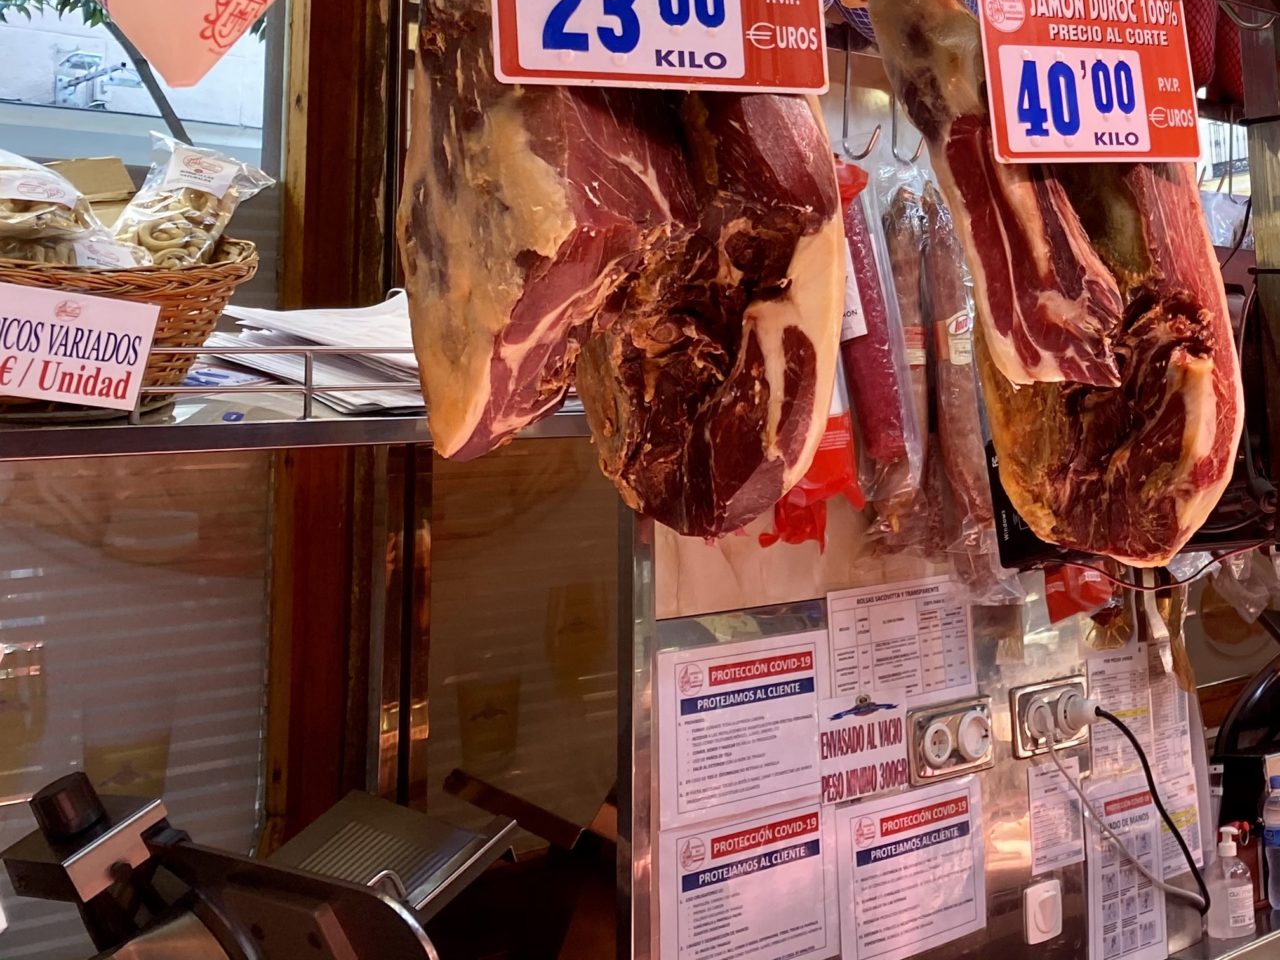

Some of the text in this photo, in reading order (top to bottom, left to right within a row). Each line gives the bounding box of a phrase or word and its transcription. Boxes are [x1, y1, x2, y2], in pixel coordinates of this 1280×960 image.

[1049, 24, 1169, 46] PRECIO AL CORTE
[655, 49, 727, 69] KILO
[1094, 132, 1139, 146] KILO
[0, 318, 143, 366] ICOS VARIADOS
[38, 360, 132, 401] Unidad
[711, 655, 811, 682] PROTECCIÓN COVID-19
[697, 682, 801, 710] PROTEJAMOS AL CLIENTE
[820, 717, 903, 760] ENVASADO AL VACIO
[821, 771, 844, 803] PESO
[882, 800, 967, 833] PROTECCIÓN COVID-19
[713, 817, 817, 855] PROTECCIÓN COVID-19
[870, 826, 960, 860] PROTEJAMOS AL CLIENTE
[698, 846, 806, 885] PROTEJAMOS AL CLIENTE
